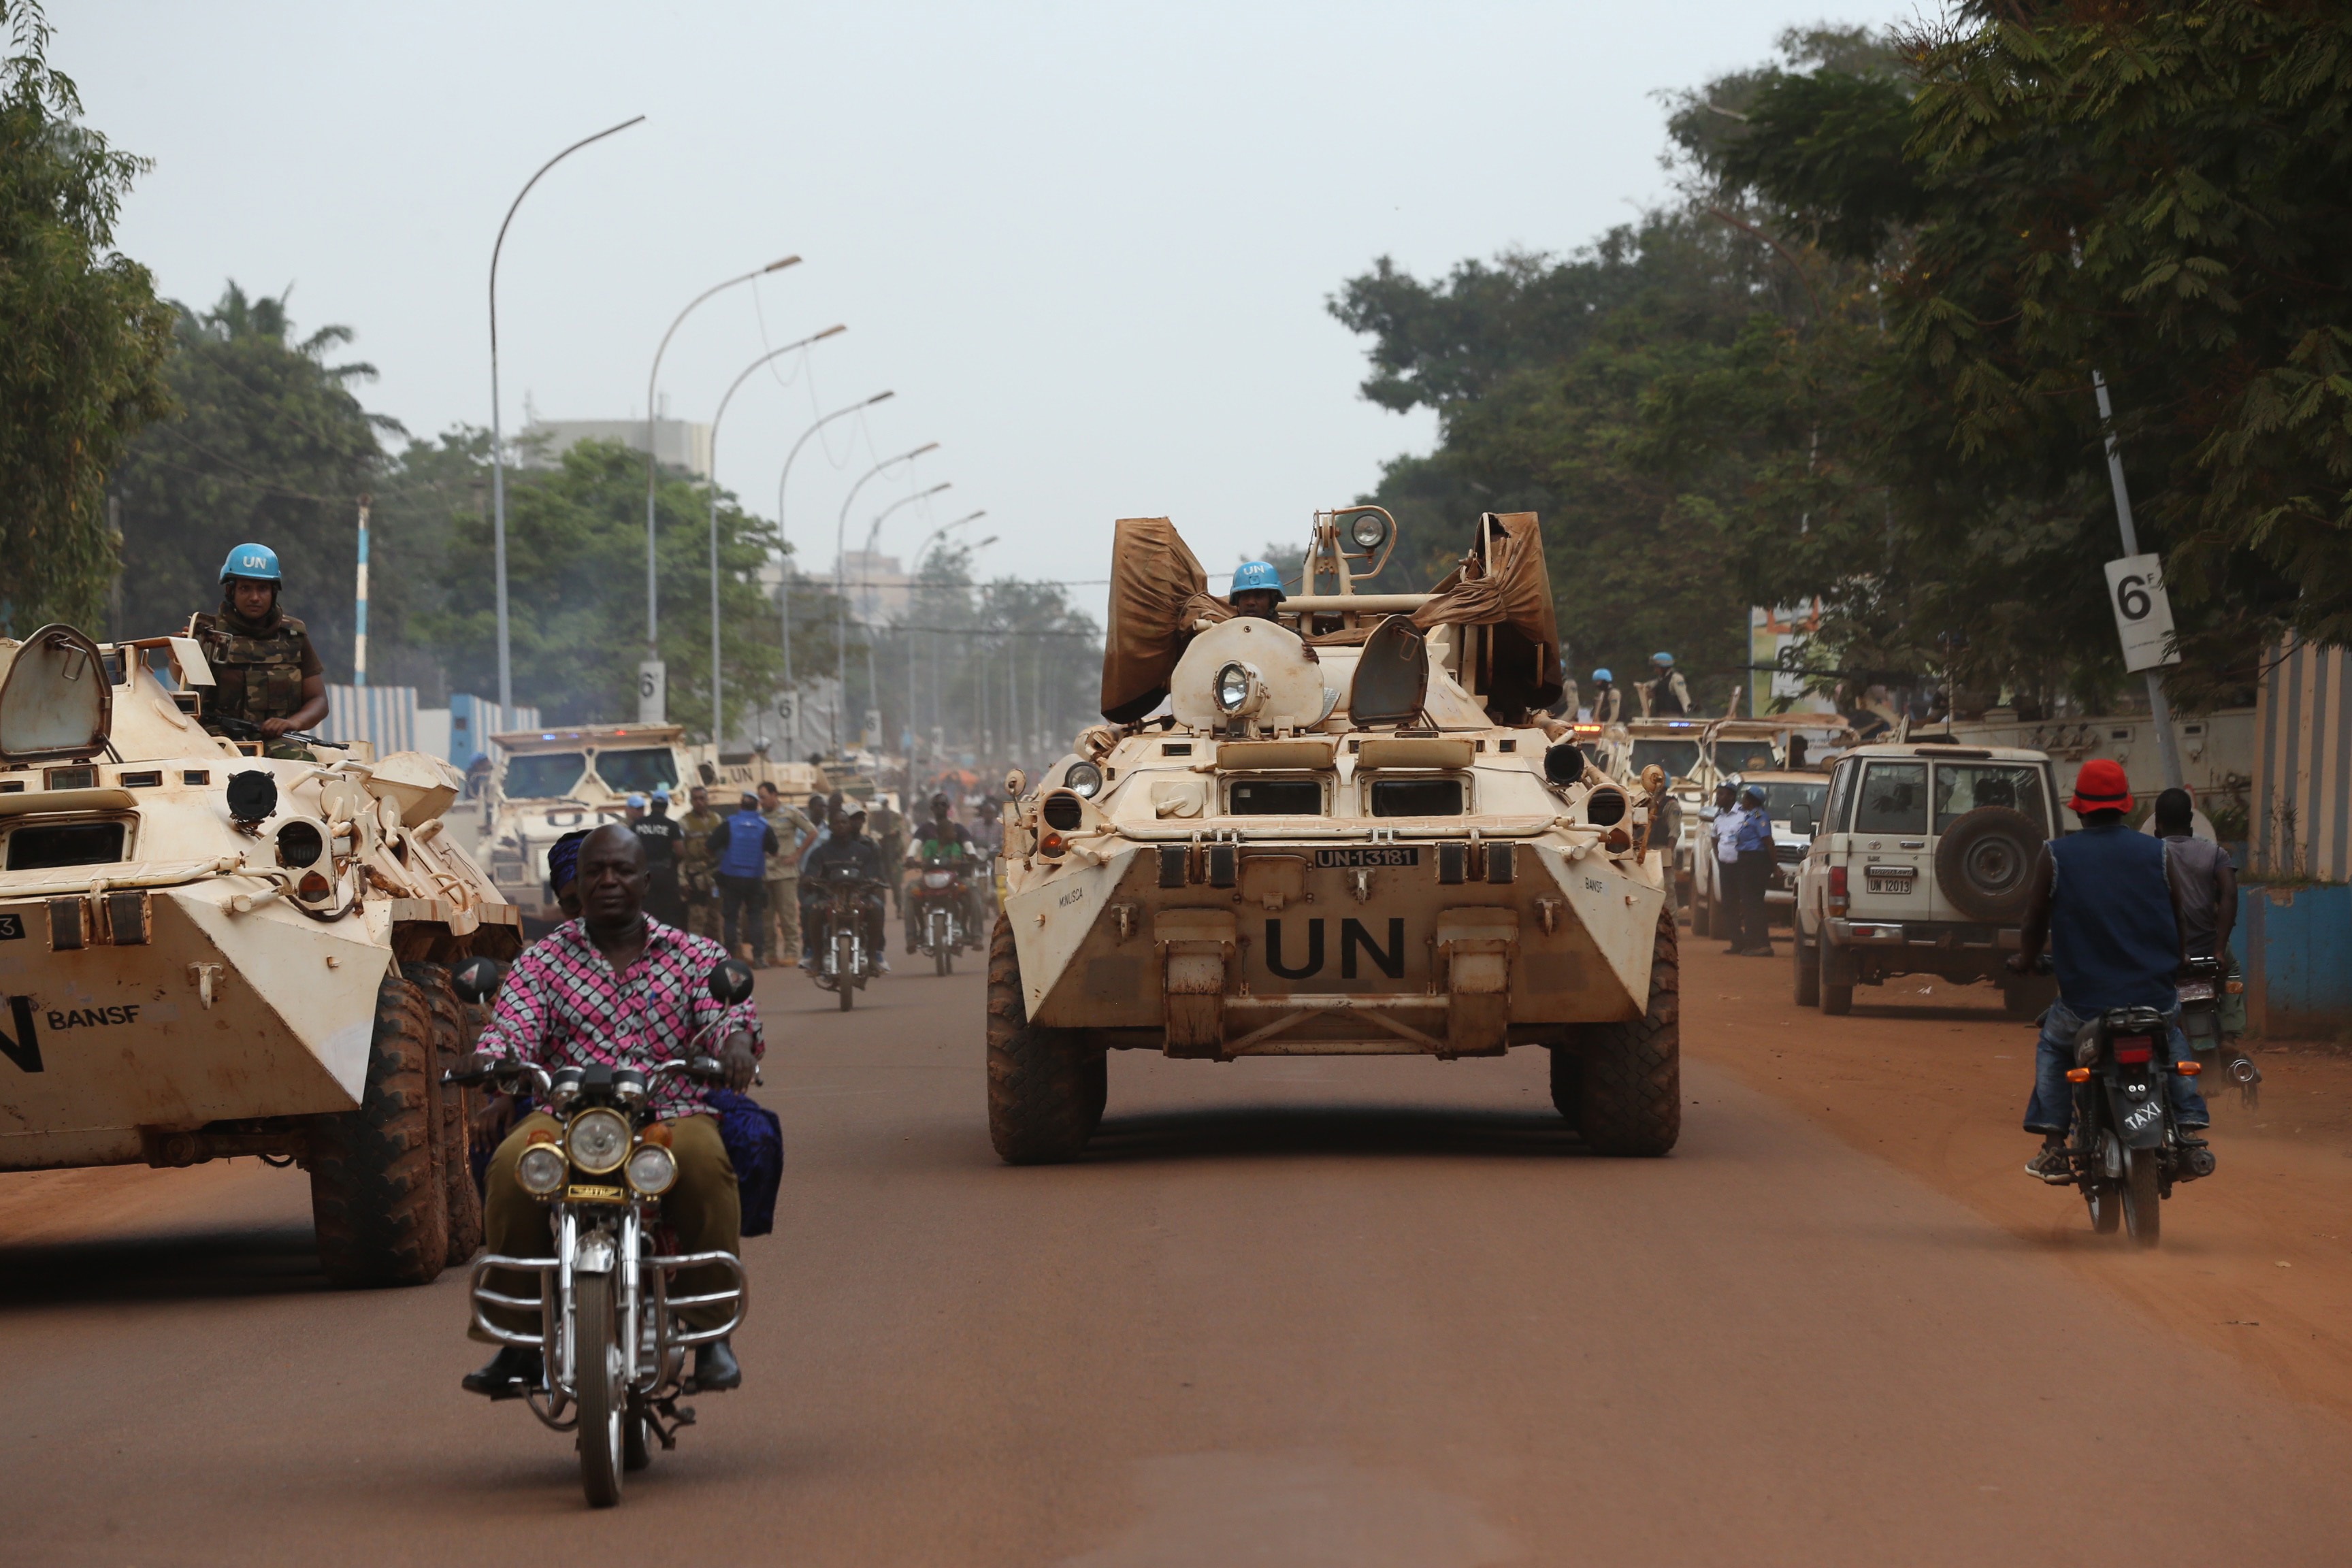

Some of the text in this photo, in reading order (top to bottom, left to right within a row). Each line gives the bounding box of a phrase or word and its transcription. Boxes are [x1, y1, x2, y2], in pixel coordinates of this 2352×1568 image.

[242, 555, 267, 570] UN
[1243, 566, 1264, 575] UN
[2118, 575, 2151, 621] 6
[641, 672, 654, 698] 6
[779, 699, 791, 719] 6
[730, 767, 753, 784] UN
[636, 823, 668, 836] POLICE
[1318, 850, 1411, 867] UN-13181
[1870, 879, 1909, 892] UN 12013
[1265, 917, 1405, 980] UN
[47, 1004, 140, 1030] BANSF
[2125, 1101, 2161, 1130] TAXI
